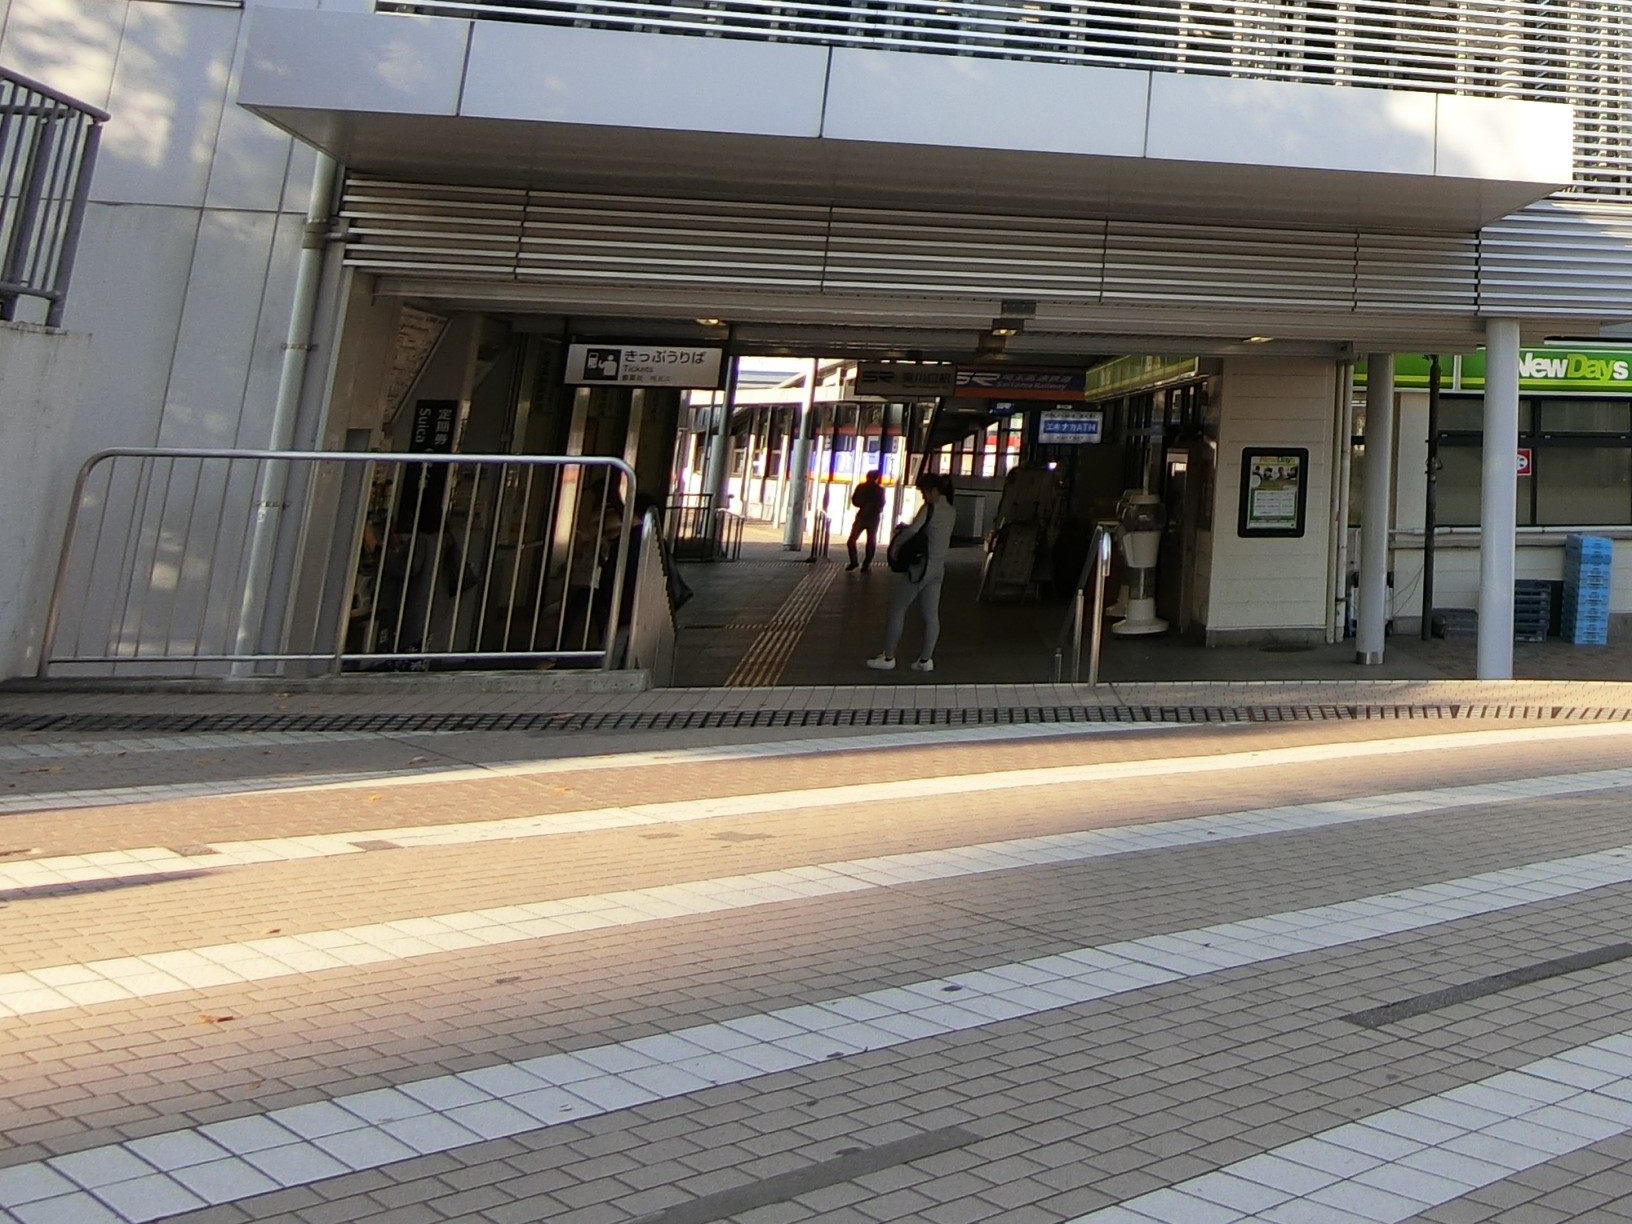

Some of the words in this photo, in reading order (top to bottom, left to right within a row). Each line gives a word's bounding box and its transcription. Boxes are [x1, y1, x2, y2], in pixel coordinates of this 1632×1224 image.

[624, 350, 706, 365] きっぷうりば
[1519, 352, 1628, 383] NewDays
[415, 407, 431, 443] Suica
[434, 408, 452, 445] 定期券
